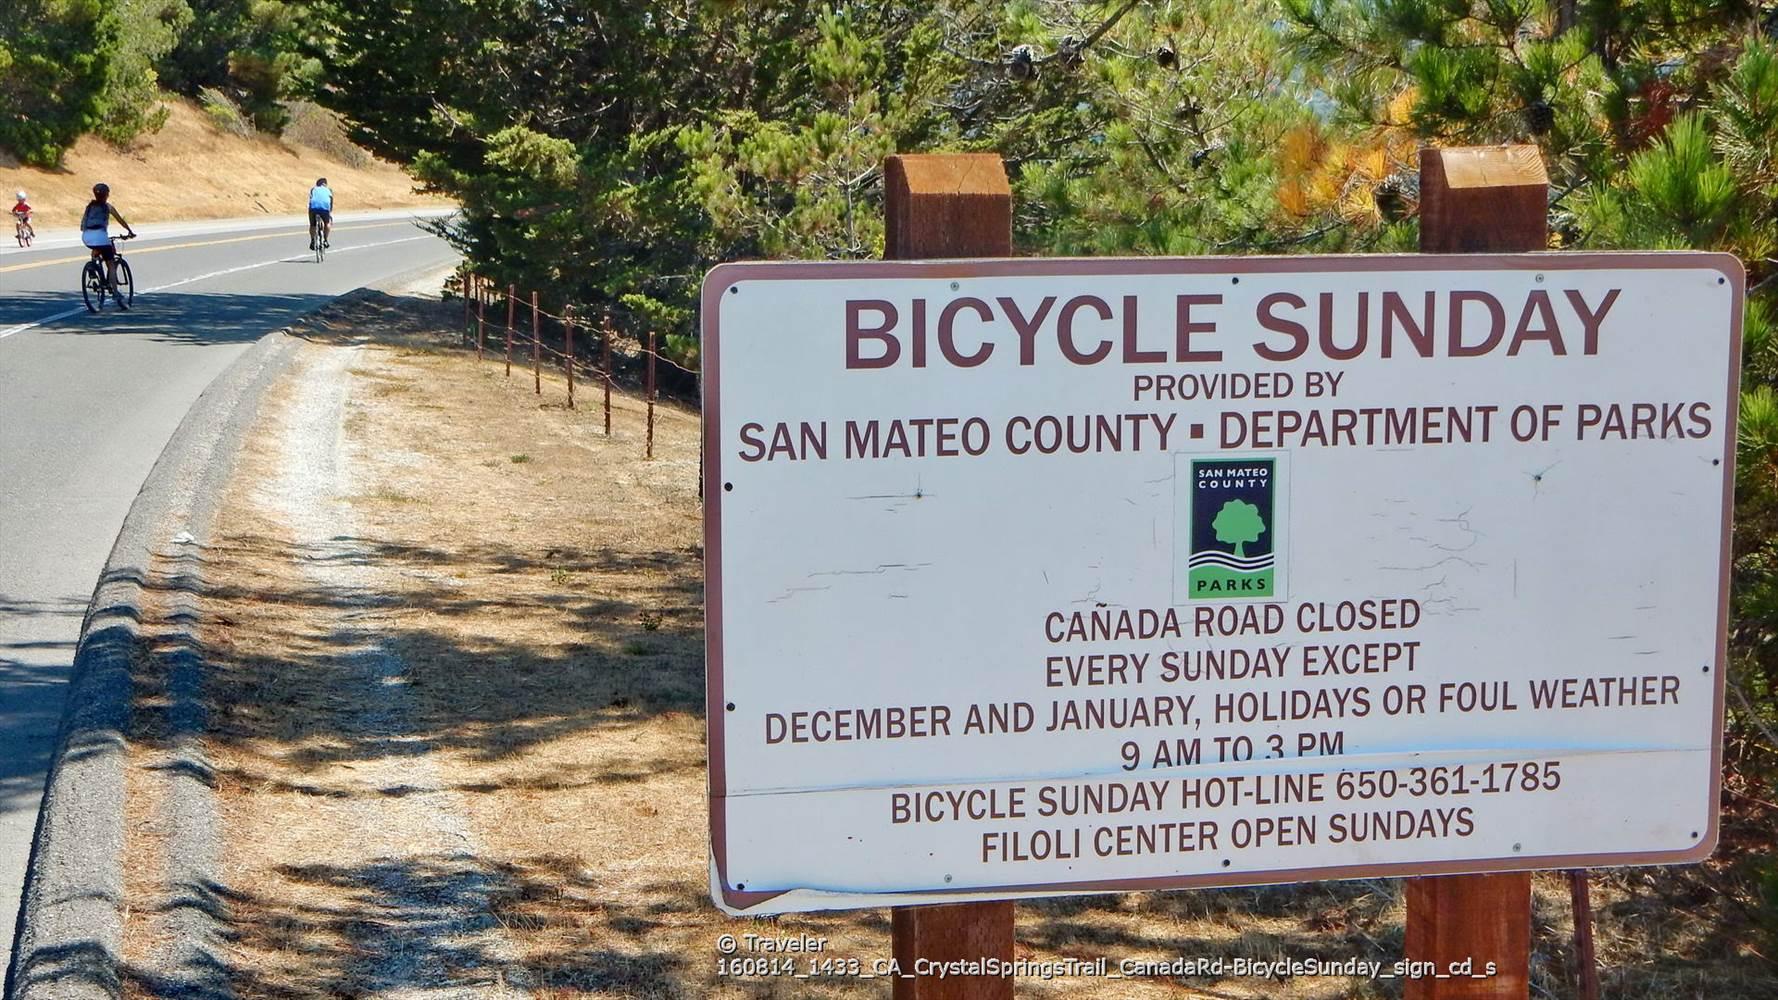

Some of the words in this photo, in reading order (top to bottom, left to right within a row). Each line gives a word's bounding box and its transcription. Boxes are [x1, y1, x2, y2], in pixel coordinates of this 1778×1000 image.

[845, 294, 1223, 369] BICYCLE
[1252, 289, 1622, 362] SUNDAY
[1133, 372, 1294, 401] PROVIDED
[1304, 371, 1344, 398] BY
[738, 420, 827, 462] SAN
[845, 416, 990, 459] MATEO
[1005, 413, 1177, 455] COUNTY
[1220, 405, 1498, 449] DEPARTMENT
[1510, 404, 1563, 442] OF
[1577, 401, 1712, 440] PARKS
[1198, 469, 1223, 478] SAN
[1226, 468, 1268, 477] MATEO
[1198, 479, 1268, 489] COUNTY
[1197, 578, 1266, 591] PARKS
[1045, 603, 1181, 643] CAÑADA
[1194, 604, 1284, 637] ROAD
[1297, 598, 1420, 633] CLOSED
[1046, 653, 1150, 687] EVERY
[1160, 647, 1292, 684] SUNDAY
[1303, 641, 1420, 676] EXCEPT
[765, 705, 951, 744] DECEMBER
[964, 702, 1035, 735] AND
[1046, 695, 1201, 731] JANUARY,
[1215, 686, 1371, 724] HOLIDAYS
[1382, 684, 1426, 716] OR
[1439, 680, 1517, 714] FOUL
[1529, 675, 1680, 710] WEATHER
[1120, 741, 1141, 771] 9
[1152, 738, 1201, 770] AM
[1215, 735, 1253, 763] TO
[1266, 734, 1284, 759] 3
[1298, 731, 1344, 757] PM
[891, 788, 1025, 824] BICYCLE
[1037, 780, 1169, 817] SUNDAY
[1181, 773, 1324, 808] HOT-LINE
[1336, 761, 1561, 800] 650-361-1785
[982, 828, 1080, 863] FILOLI
[1094, 820, 1218, 857] CENTER
[1231, 815, 1317, 849] OPEN
[1328, 807, 1475, 843] SUNDAYS
